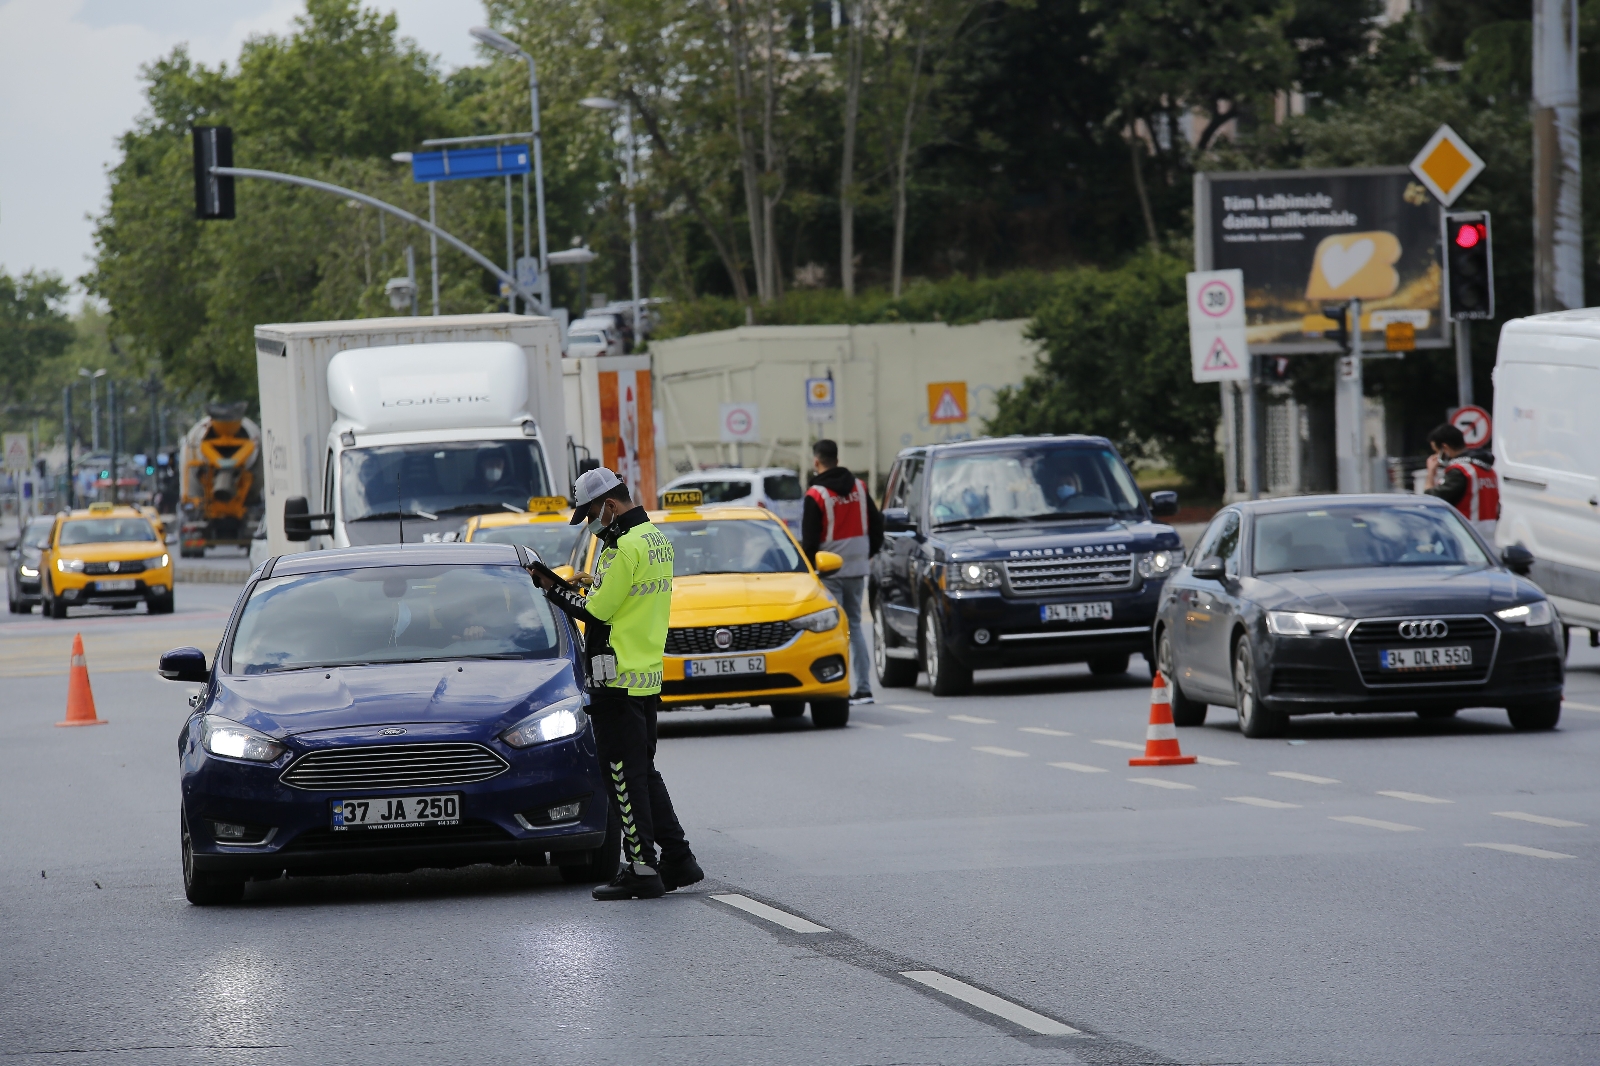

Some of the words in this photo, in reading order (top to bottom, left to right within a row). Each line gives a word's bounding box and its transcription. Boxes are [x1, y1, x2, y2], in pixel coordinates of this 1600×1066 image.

[1223, 195, 1255, 211] Tüm
[1256, 192, 1333, 210] kalbimizle
[1222, 213, 1270, 229] daima
[1270, 210, 1358, 228] milletimizle
[1010, 547, 1065, 558] RANGE
[1073, 543, 1127, 554] ROVER
[1048, 605, 1061, 619] 34
[692, 661, 706, 675] 34
[715, 659, 736, 673] TEK
[748, 657, 763, 671] 62
[1388, 651, 1405, 666] 34
[1414, 649, 1440, 665] DLR
[1445, 648, 1471, 664] 550
[344, 801, 369, 823] 37
[380, 800, 407, 821] JA
[416, 798, 457, 819] 250
